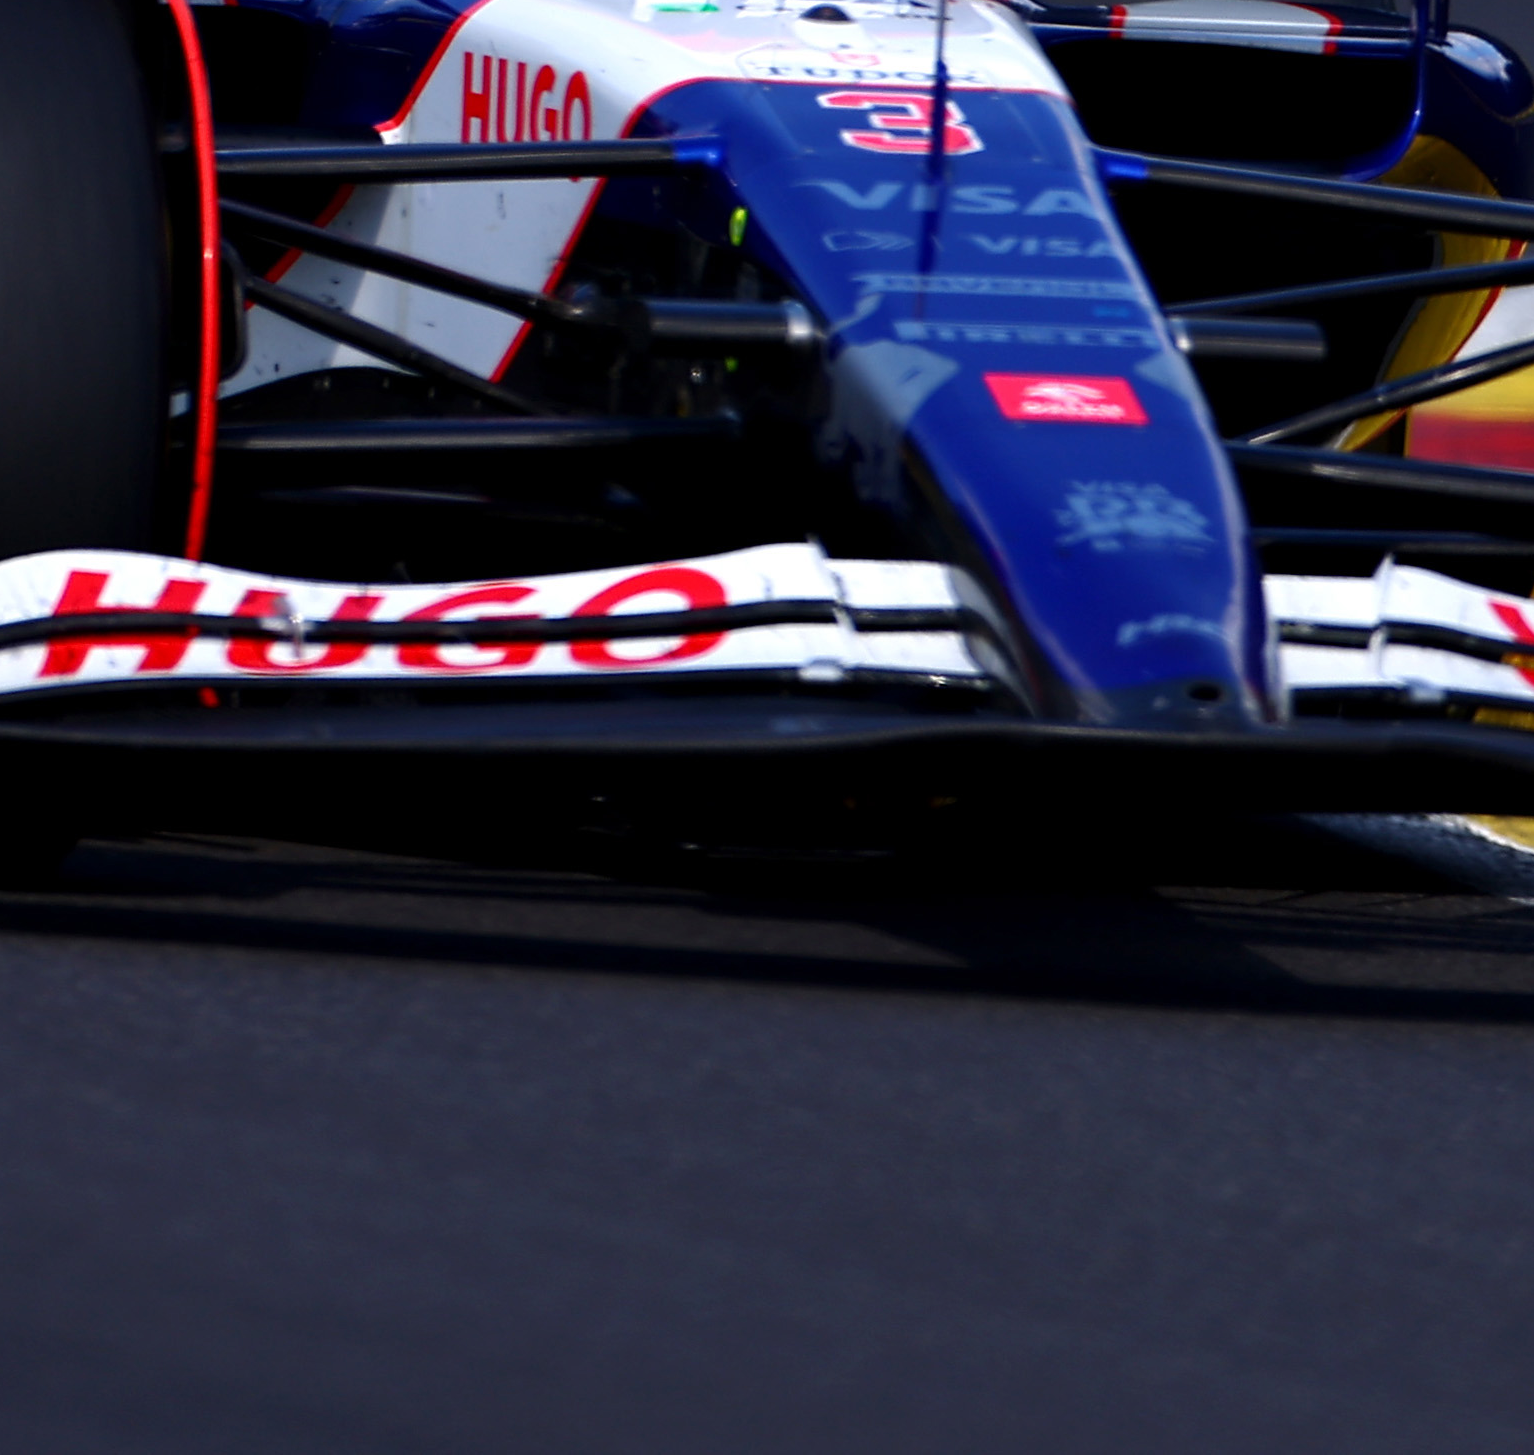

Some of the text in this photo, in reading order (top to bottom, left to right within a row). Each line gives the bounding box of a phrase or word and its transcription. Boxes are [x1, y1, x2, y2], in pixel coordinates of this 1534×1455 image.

[463, 52, 592, 146] HUGO
[816, 90, 986, 155] 3
[795, 179, 1103, 220] VISA
[38, 567, 728, 679] HUGO
